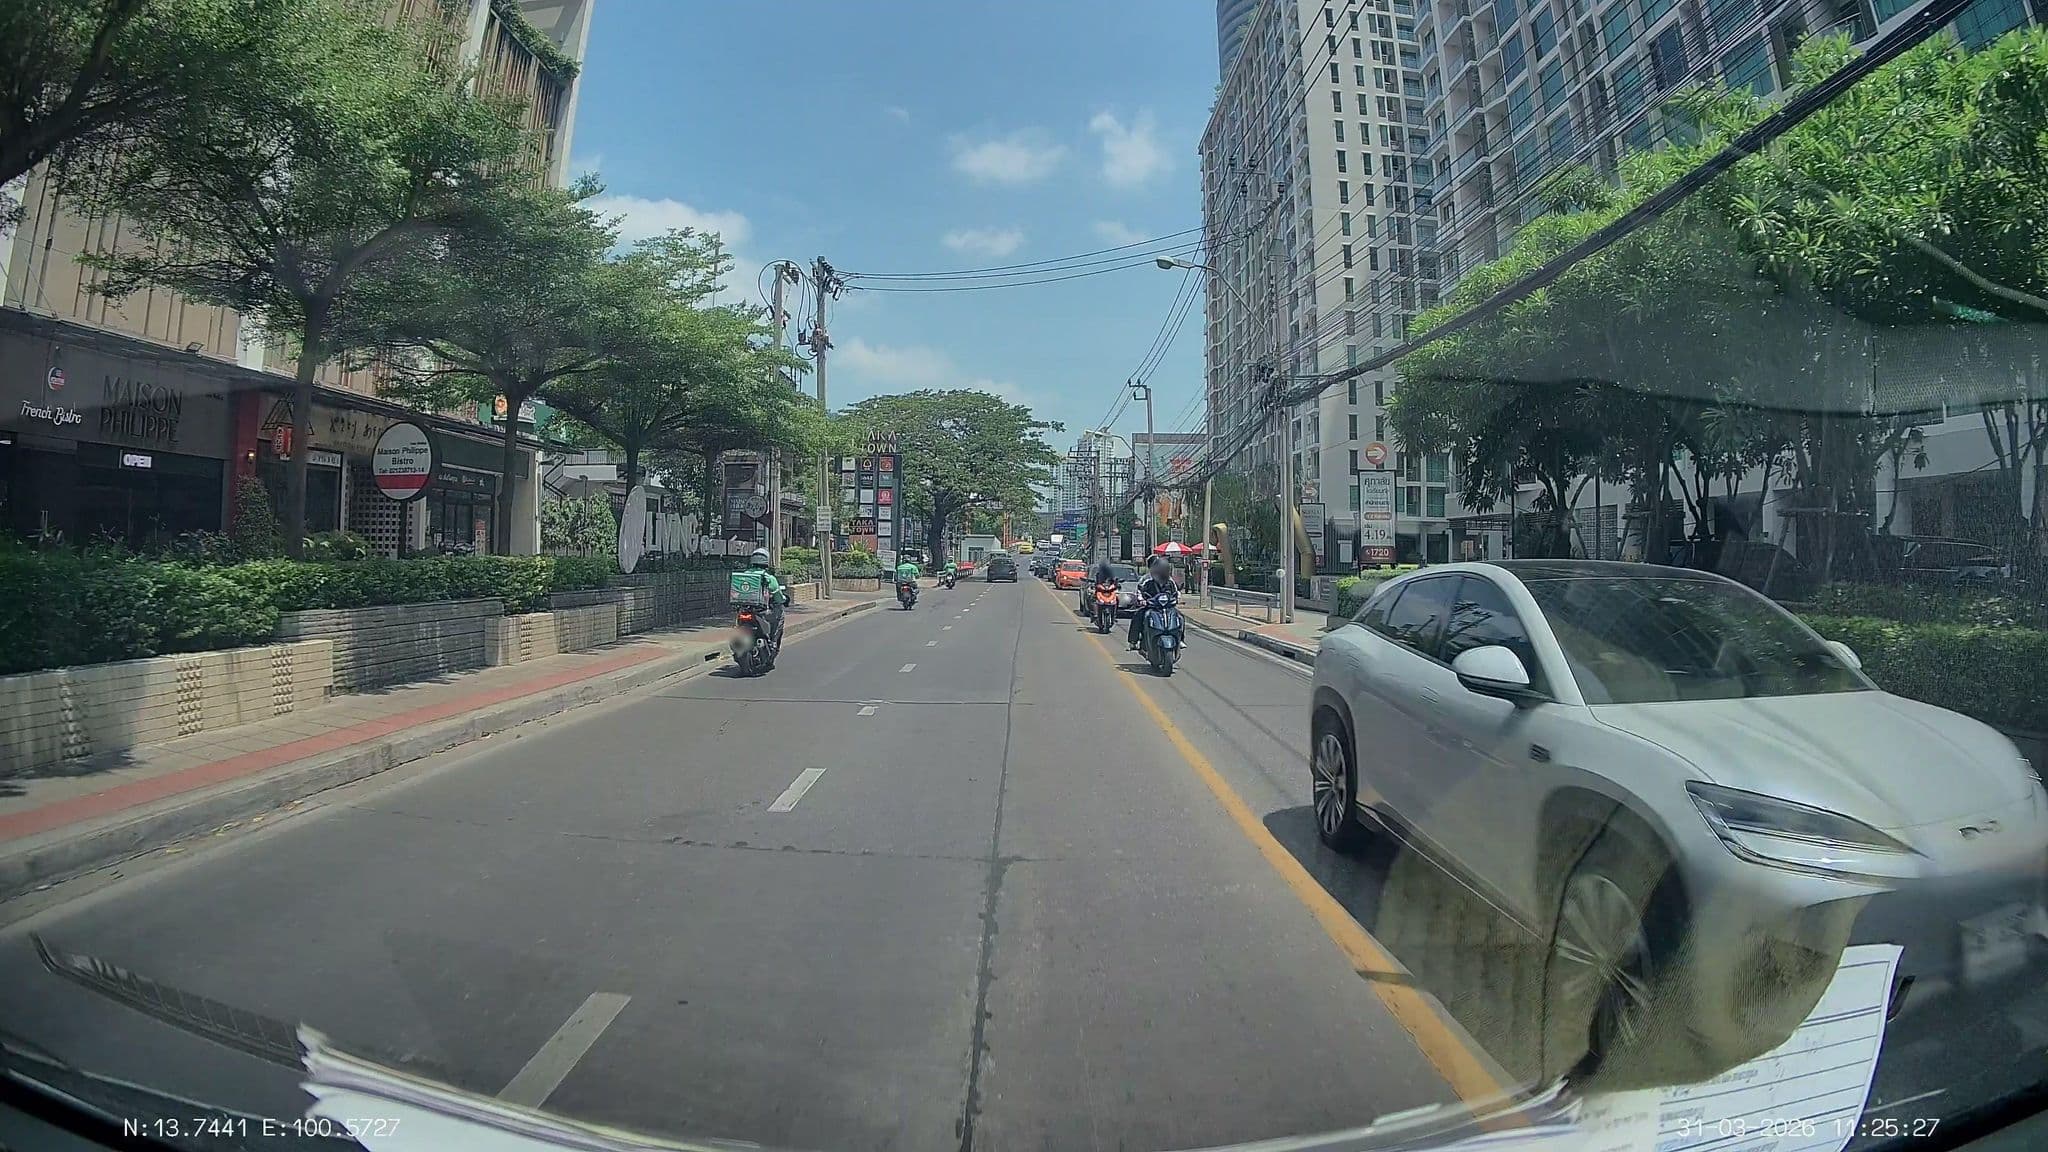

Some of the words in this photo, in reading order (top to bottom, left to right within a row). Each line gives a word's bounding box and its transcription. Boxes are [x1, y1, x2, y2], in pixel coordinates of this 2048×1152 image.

[104, 376, 183, 416] MAISON
[20, 400, 52, 420] French
[53, 406, 82, 426] Bistro
[100, 407, 180, 443] PHILIPPE
[402, 447, 429, 456] Philippe
[123, 453, 153, 469] OPEN
[392, 457, 414, 465] Bistro
[1364, 529, 1386, 540] 4.19
[1371, 548, 1389, 557] 1720
